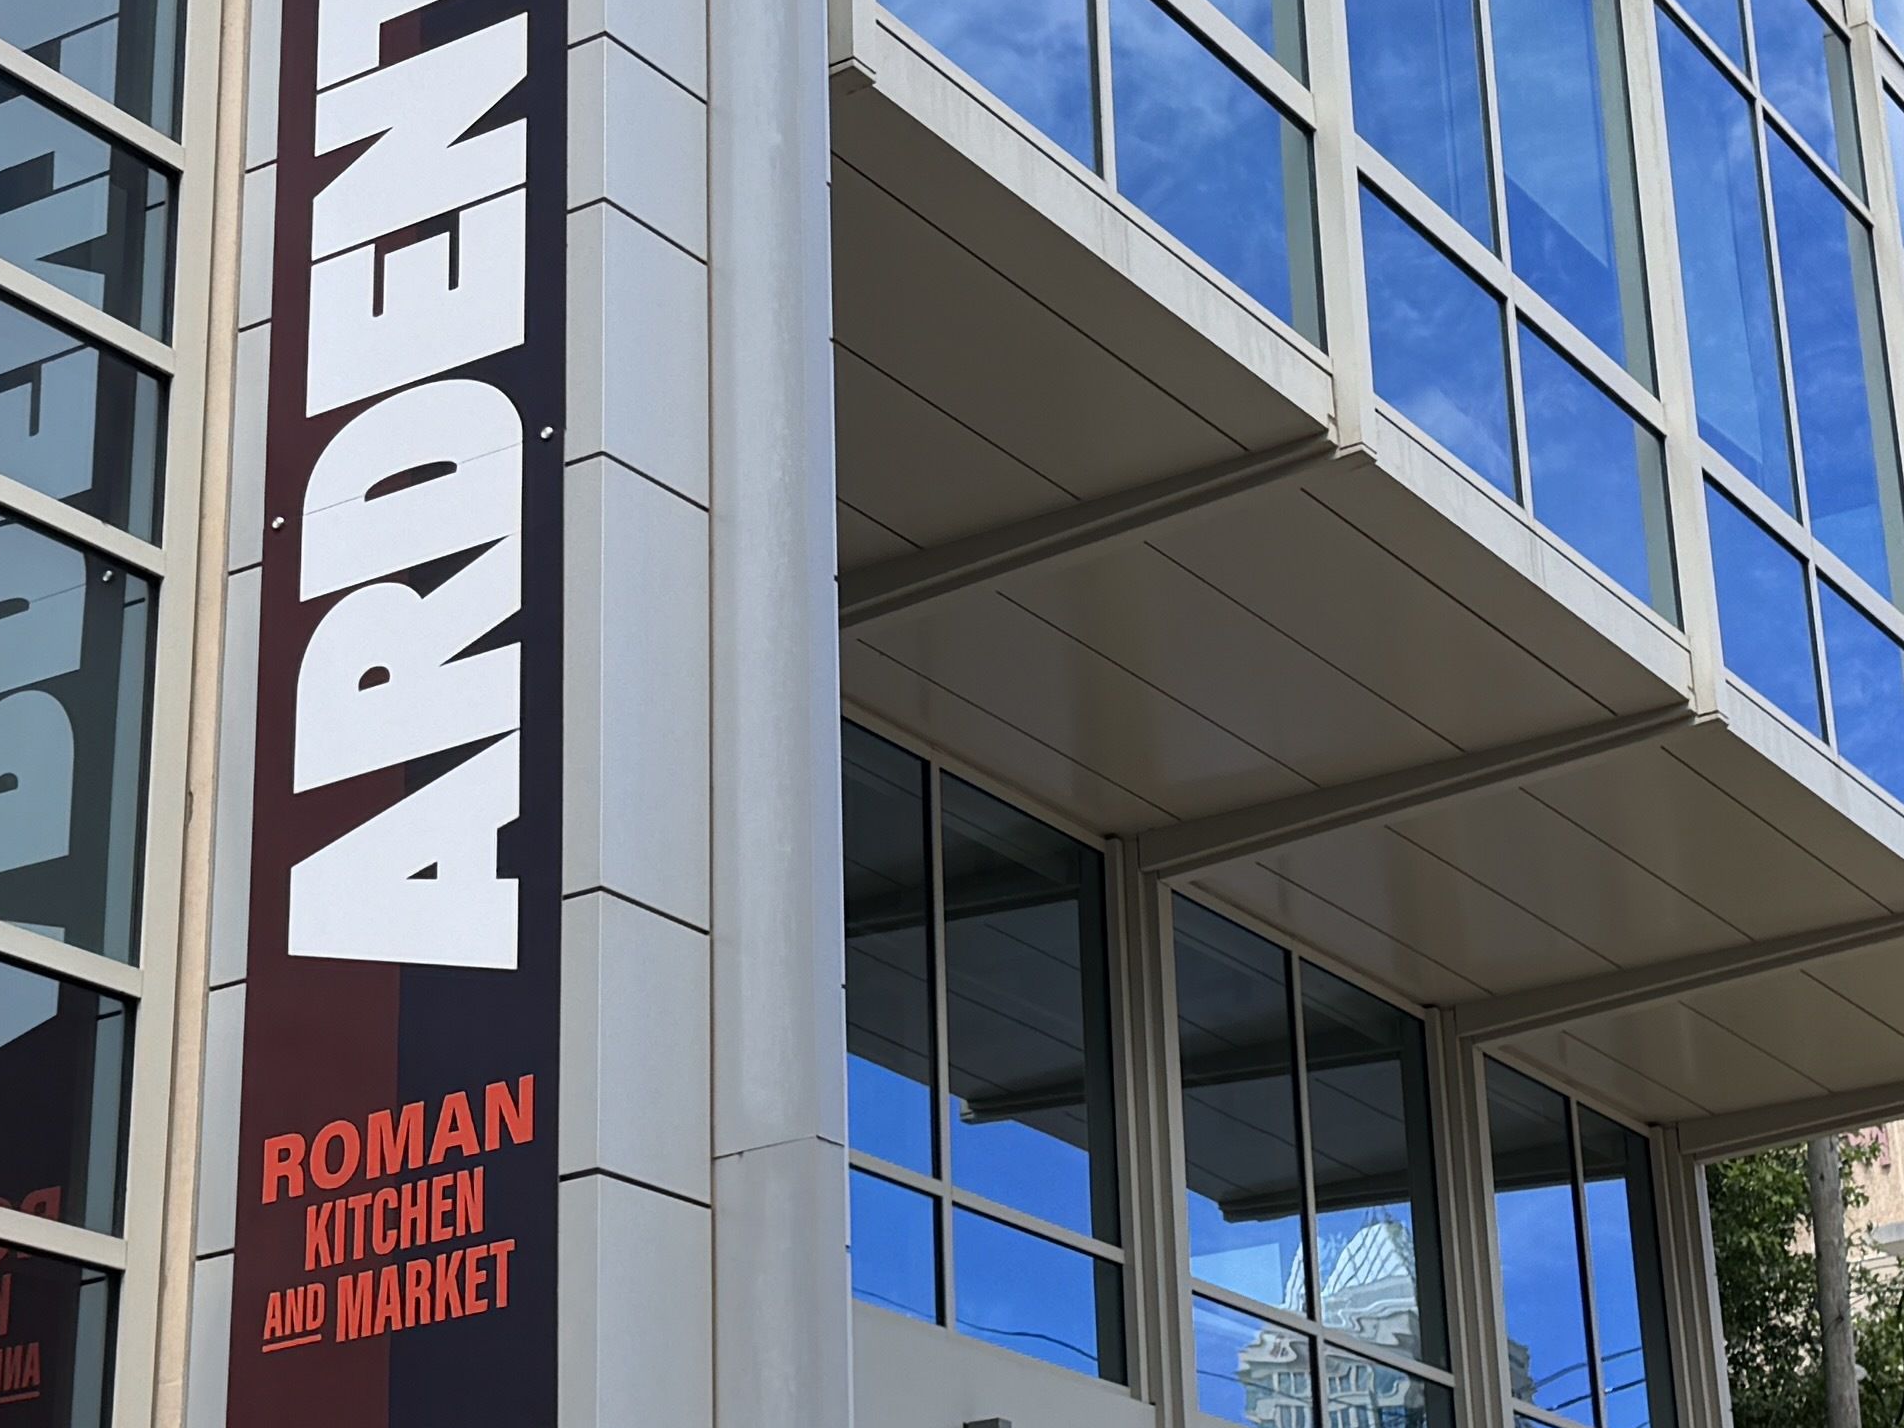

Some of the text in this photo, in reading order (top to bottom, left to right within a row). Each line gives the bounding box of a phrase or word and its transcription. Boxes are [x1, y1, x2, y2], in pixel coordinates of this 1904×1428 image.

[262, 1074, 534, 1204] ROMAN
[305, 1166, 484, 1270] KITCHEN
[263, 1239, 515, 1342] AND MARKET
